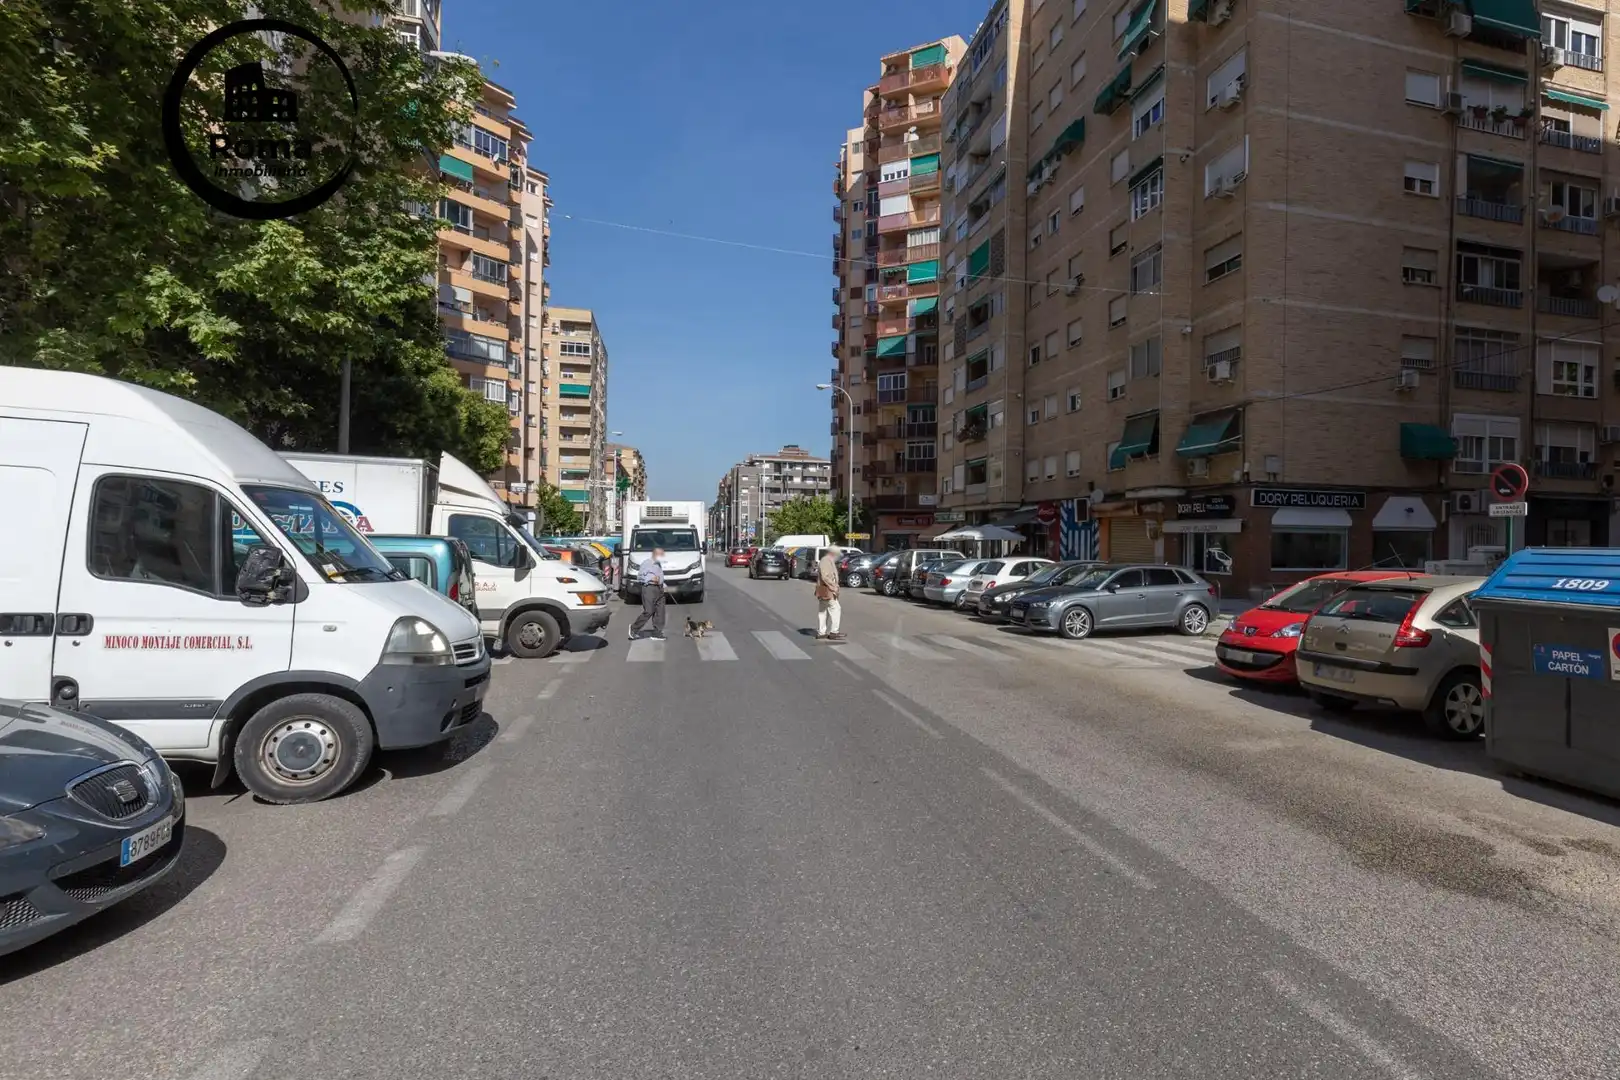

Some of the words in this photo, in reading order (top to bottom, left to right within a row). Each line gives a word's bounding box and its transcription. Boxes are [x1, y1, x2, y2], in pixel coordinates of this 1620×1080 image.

[1260, 493, 1289, 504] DORY
[1291, 494, 1360, 506] PELUQUERIA
[1552, 578, 1609, 591] 1809
[104, 635, 139, 649] MINOCO
[141, 635, 181, 649] MONTAJE
[236, 635, 253, 649] S.L.
[1552, 650, 1583, 662] PAPEL
[1548, 660, 1589, 675] CARTÓN
